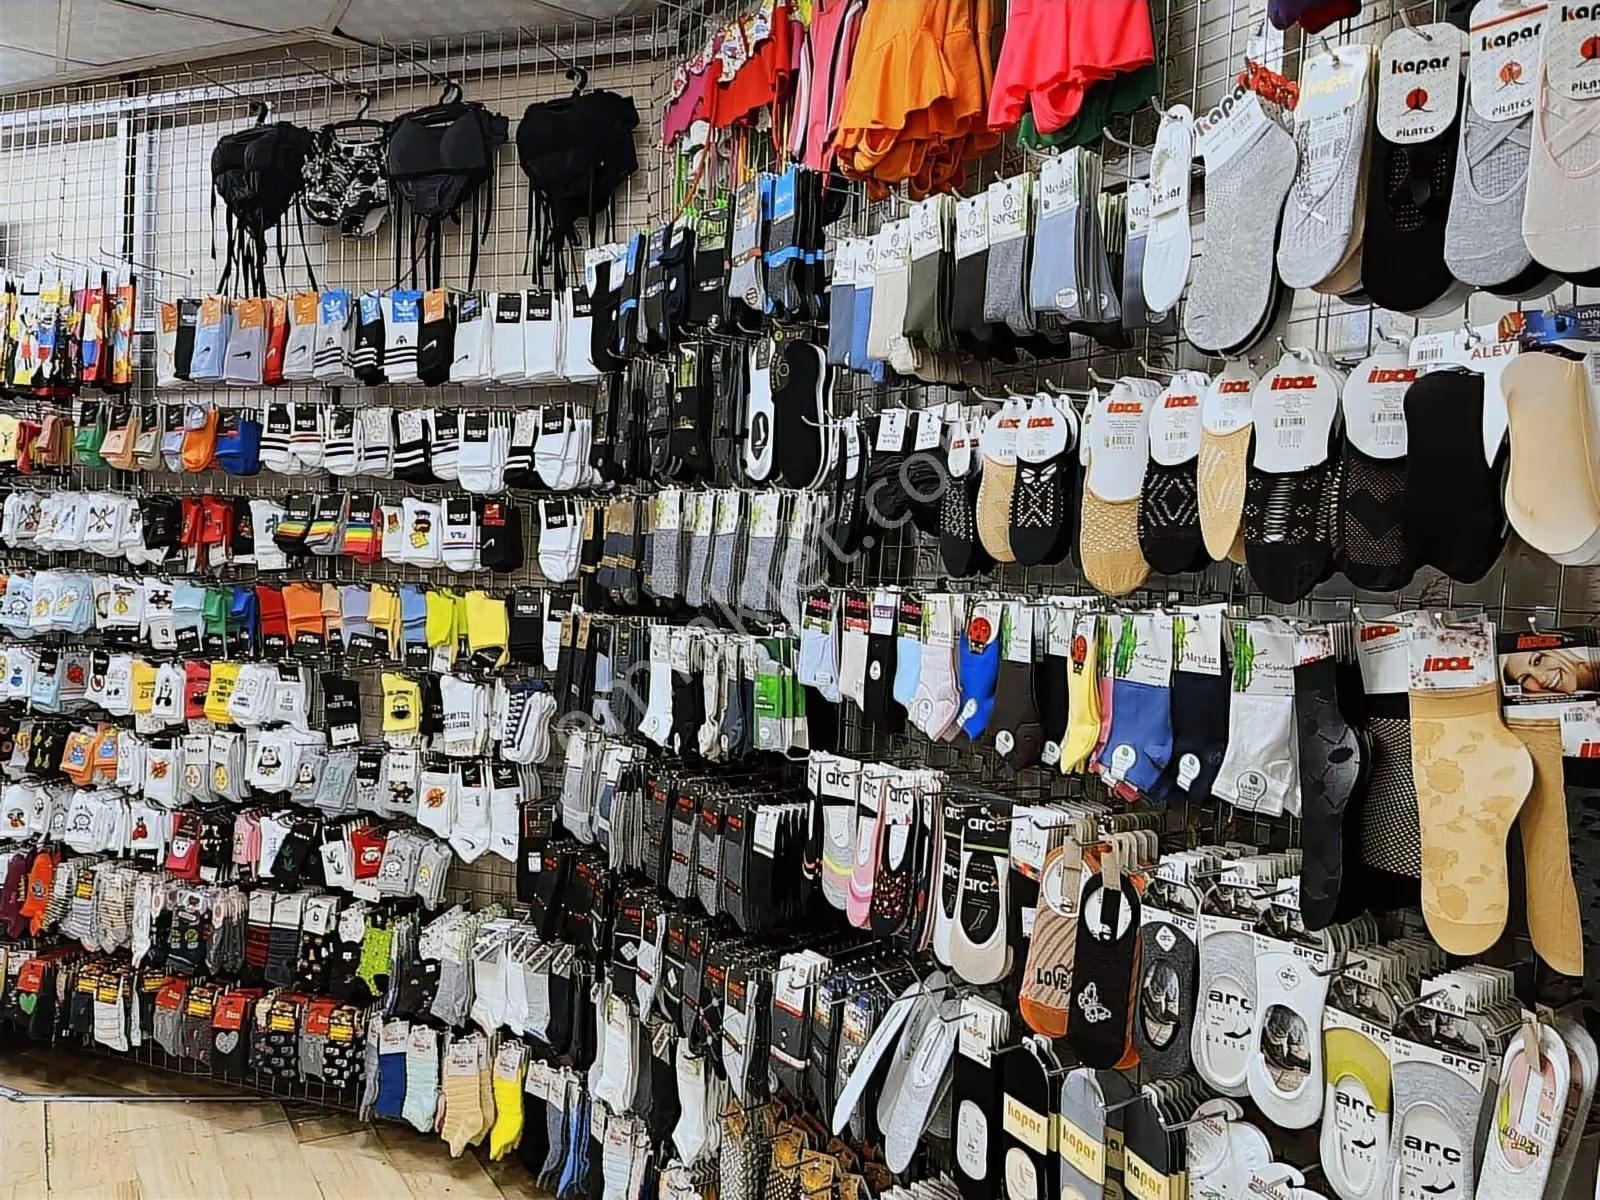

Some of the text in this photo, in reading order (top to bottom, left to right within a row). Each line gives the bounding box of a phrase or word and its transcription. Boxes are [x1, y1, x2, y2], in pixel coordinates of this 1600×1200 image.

[1482, 23, 1541, 51] kapar
[1392, 57, 1450, 74] kapar
[1471, 343, 1513, 360] ALEV
[826, 772, 850, 787] arc
[863, 781, 877, 798] arc
[889, 789, 909, 805] arc
[944, 806, 961, 820] arc
[968, 817, 995, 832] arc
[944, 862, 959, 879] arc
[964, 877, 990, 893] arc
[1172, 916, 1196, 931] arc
[1036, 968, 1068, 990] LOVE
[1008, 1100, 1041, 1133] kapar
[1063, 1124, 1097, 1161] kapar
[1127, 1155, 1162, 1194] kapar
